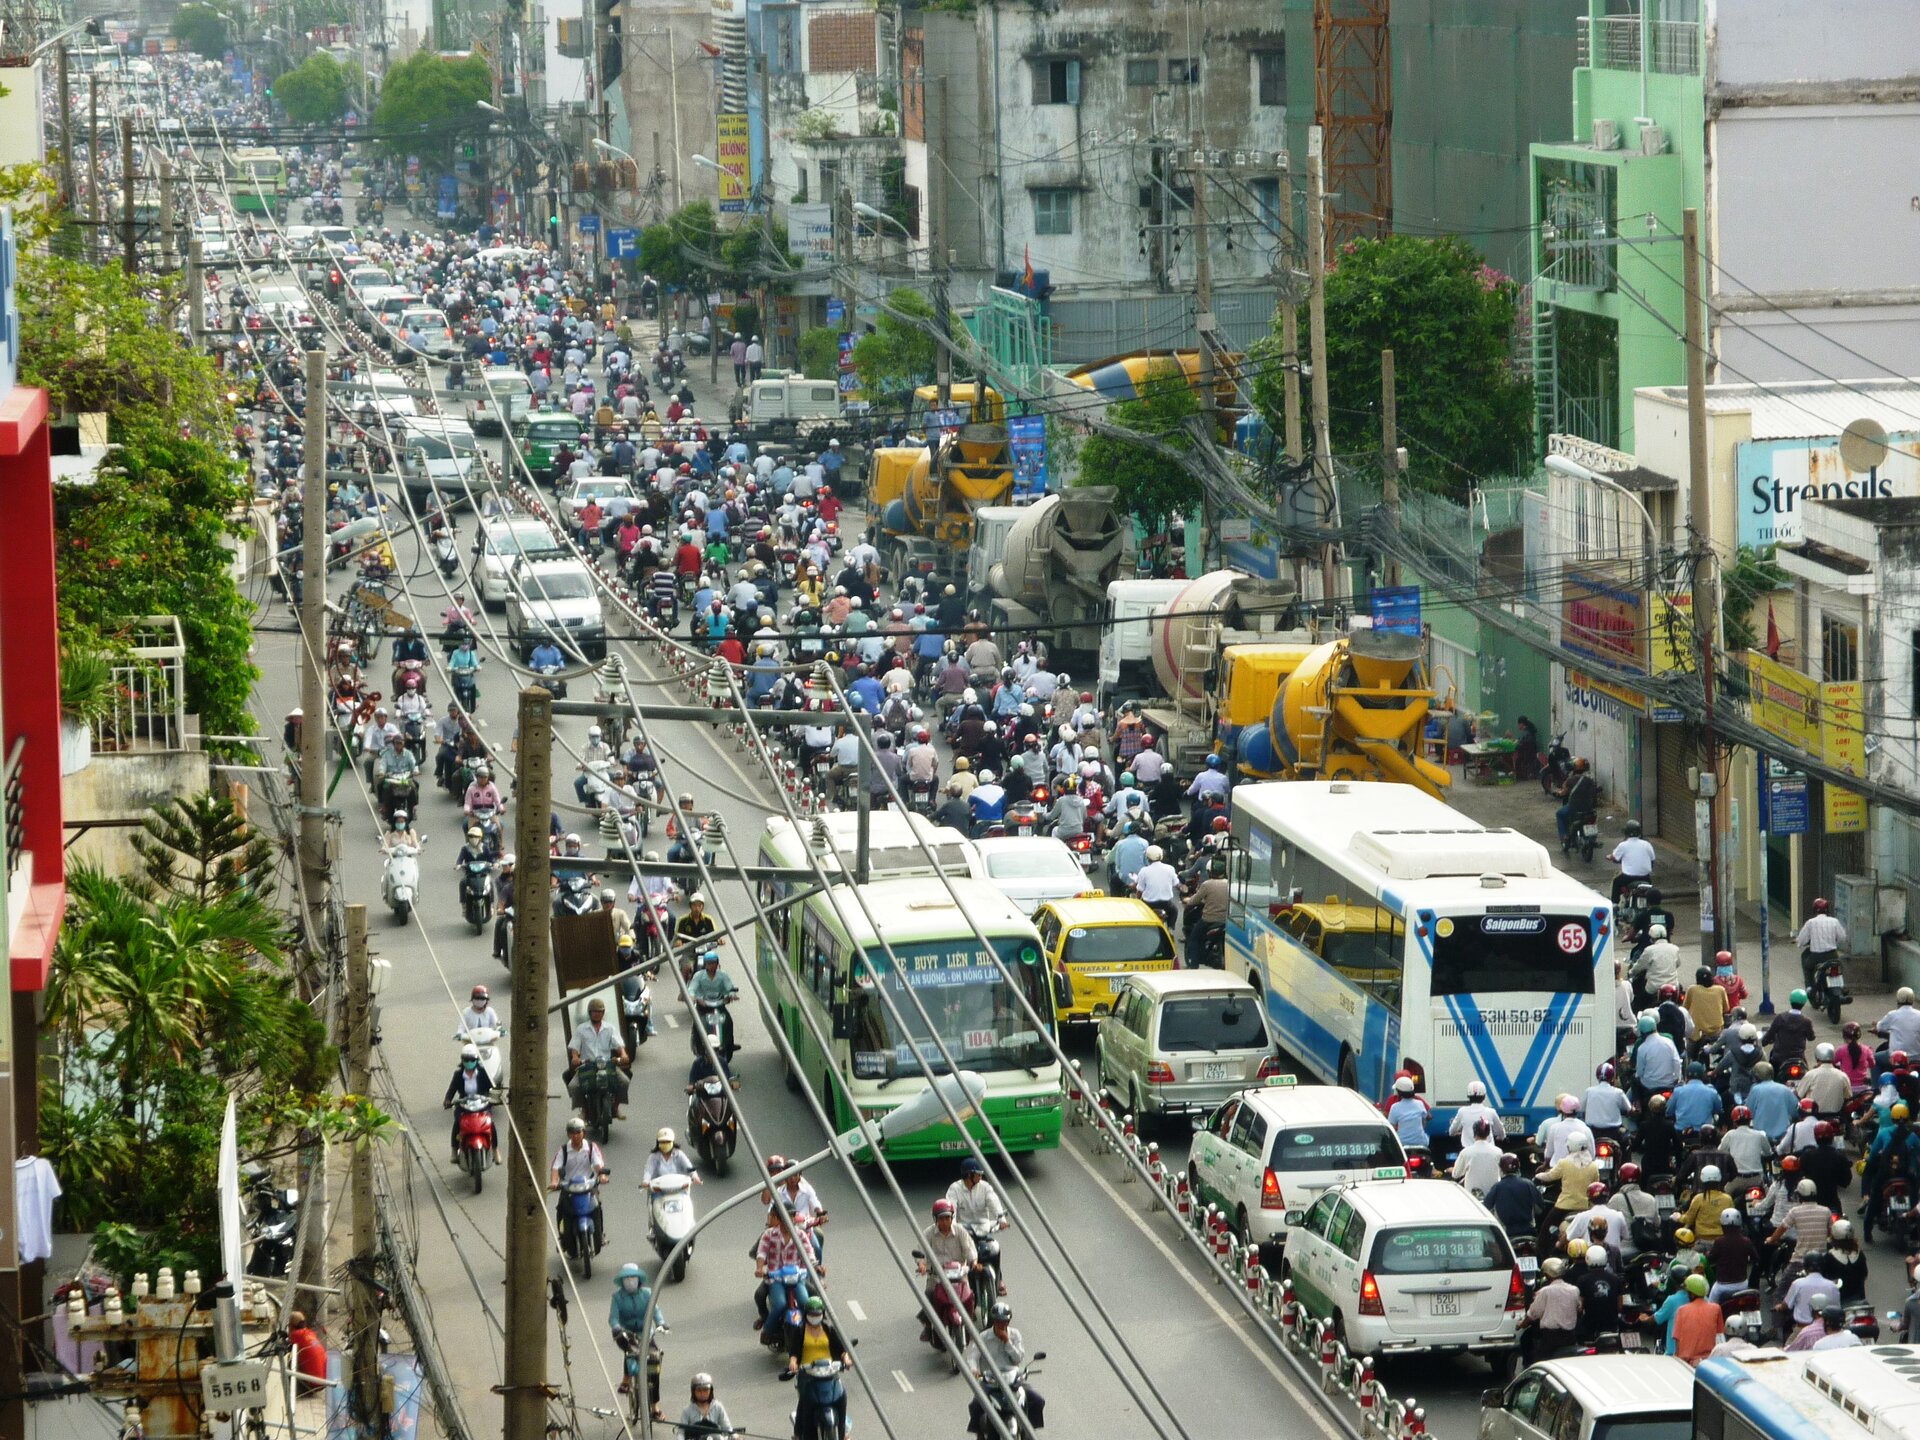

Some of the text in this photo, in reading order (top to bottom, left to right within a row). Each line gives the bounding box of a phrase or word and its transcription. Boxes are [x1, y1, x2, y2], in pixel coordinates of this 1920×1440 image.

[1757, 522, 1796, 540] THUỐC
[1485, 918, 1541, 931] SaigonBus
[1562, 929, 1584, 949] 55
[1071, 965, 1110, 973] VINATAXI
[967, 1031, 993, 1046] 104
[1504, 1116, 1520, 1125] 53N
[1320, 1145, 1333, 1157] 38
[1334, 1144, 1347, 1156] 38
[1349, 1144, 1362, 1155] 38
[1363, 1143, 1376, 1155] 38
[1380, 1169, 1401, 1177] TAXI
[1416, 1244, 1430, 1256] 38
[1433, 1243, 1447, 1256] 38
[1450, 1243, 1464, 1255] 38
[1434, 1293, 1452, 1304] 52U
[1433, 1304, 1456, 1314] 1153
[211, 1378, 261, 1399] 5568
